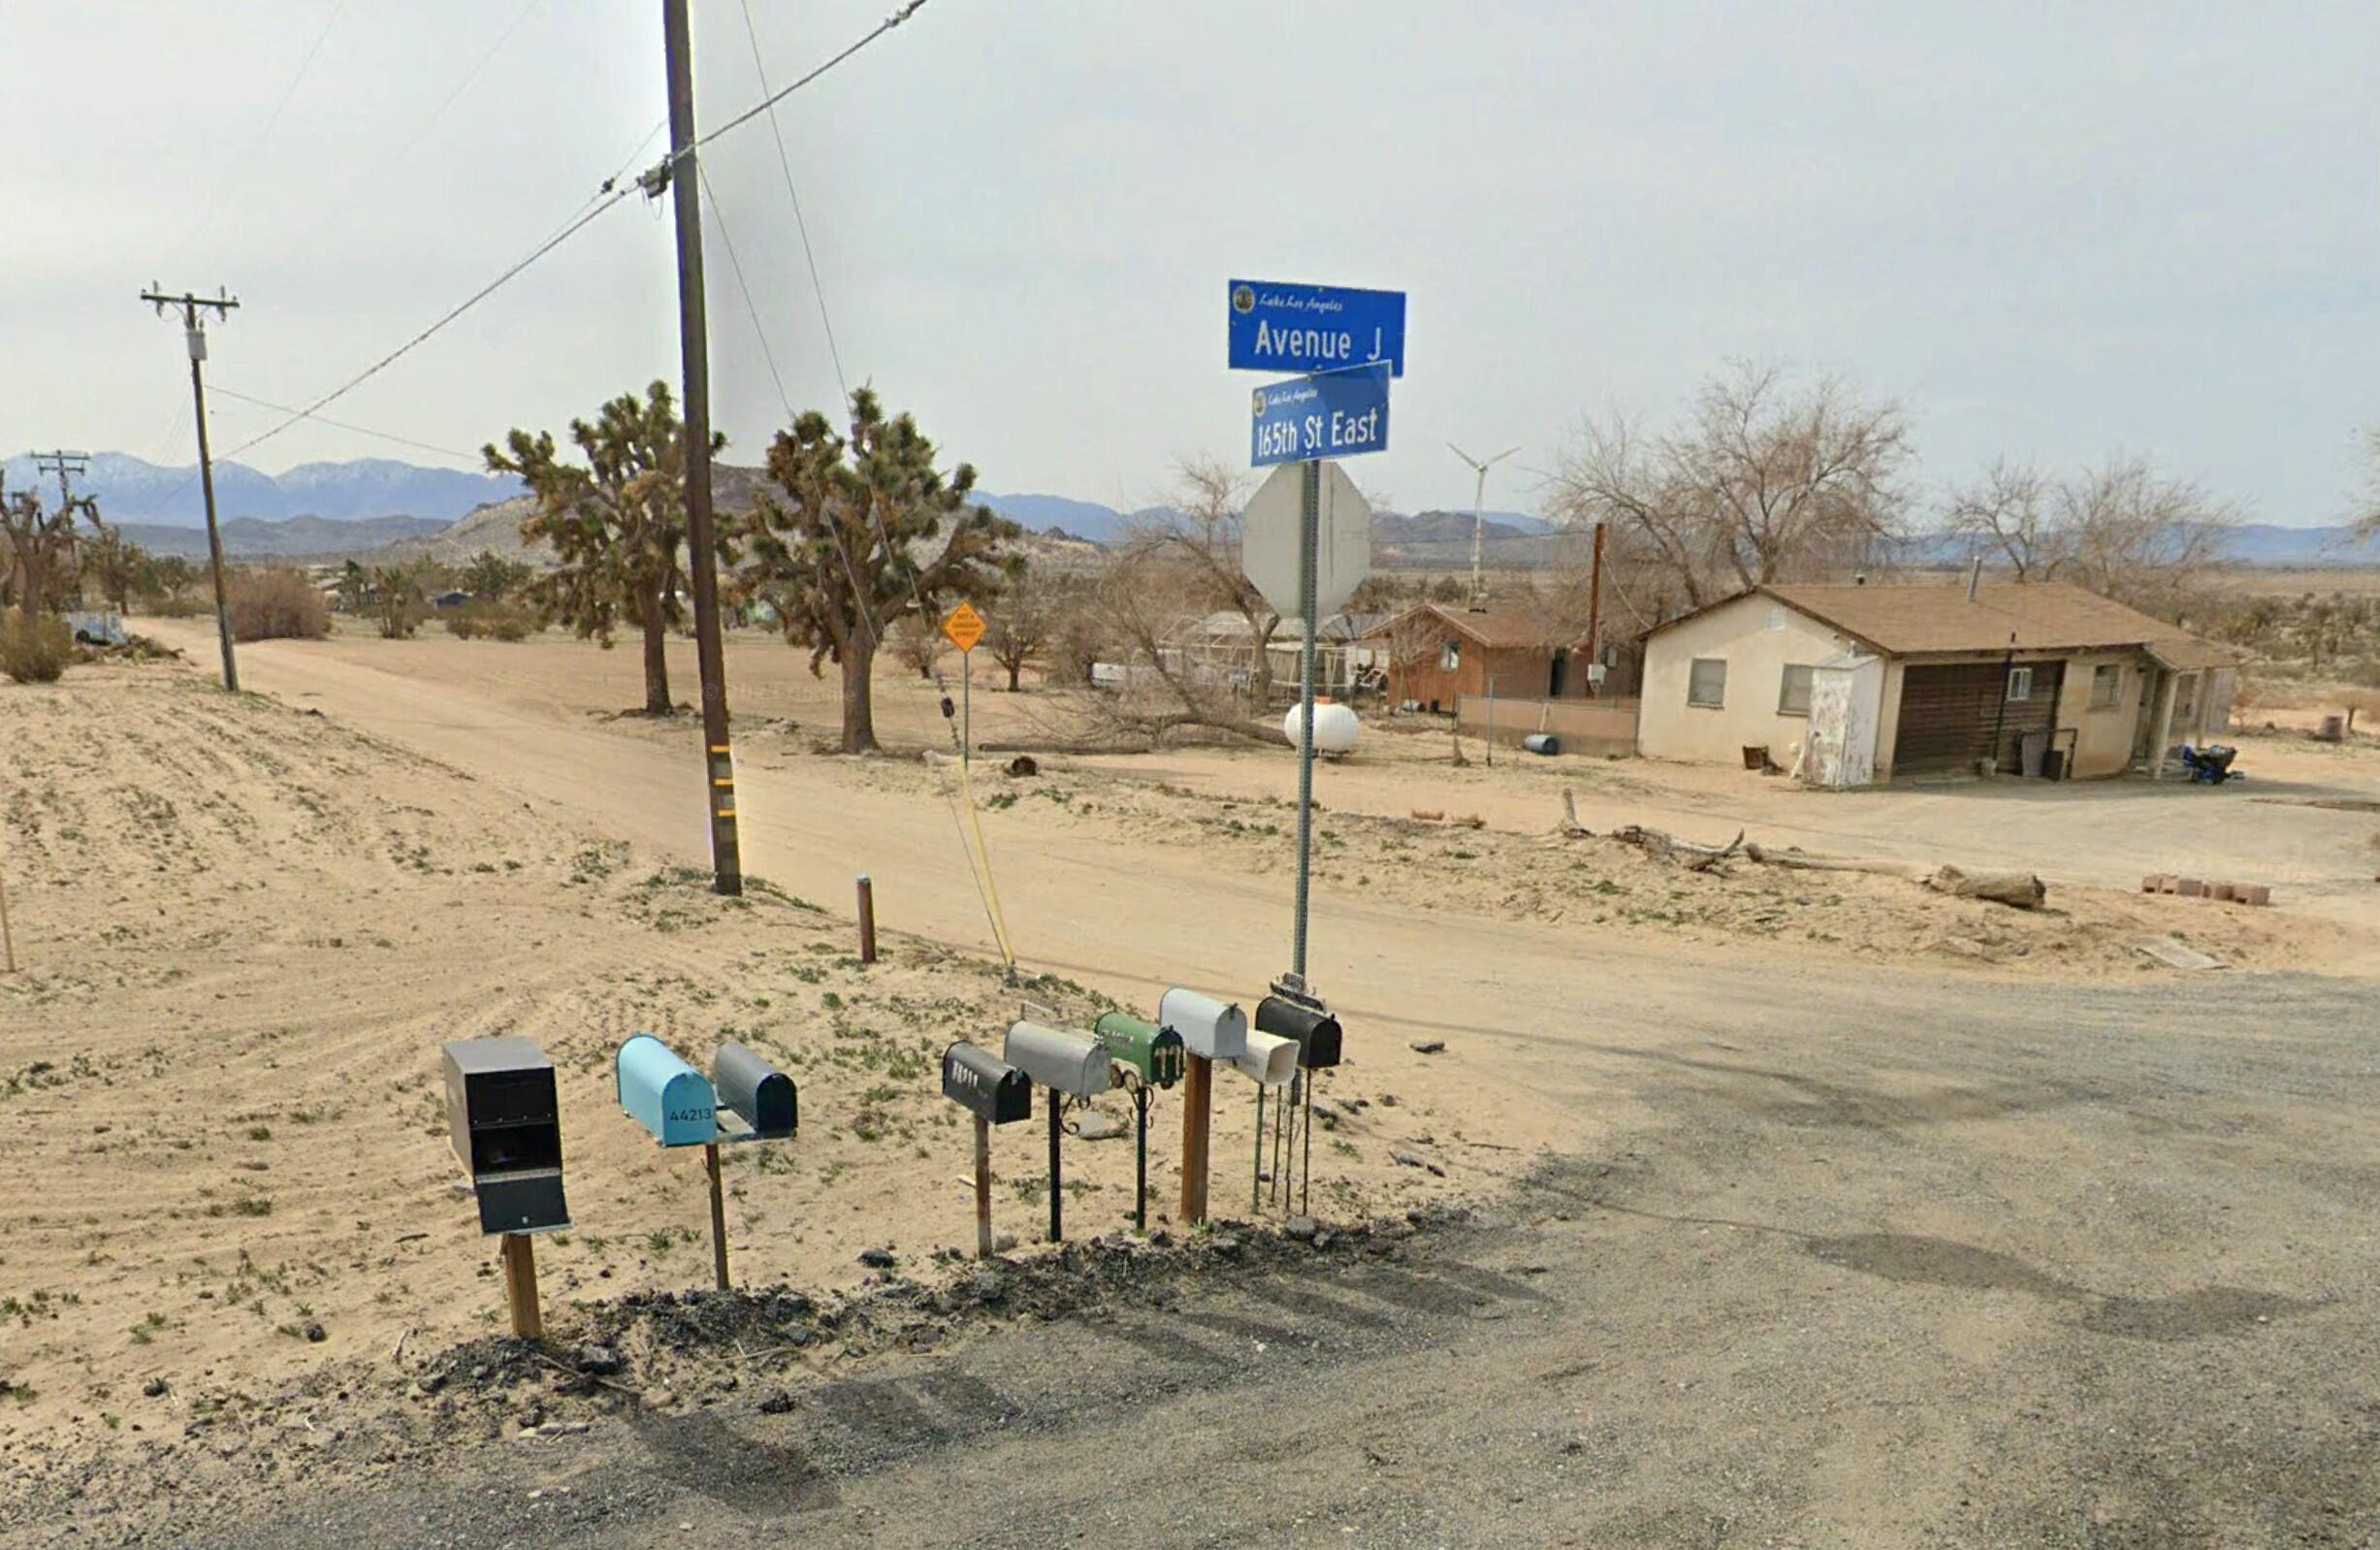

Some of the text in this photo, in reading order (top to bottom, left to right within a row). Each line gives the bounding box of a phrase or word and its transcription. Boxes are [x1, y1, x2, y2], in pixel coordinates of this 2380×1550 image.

[1259, 293, 1343, 314] Lake Los Angeles
[1254, 319, 1382, 361] Avenue J
[1258, 406, 1378, 458] 165th St East
[669, 1109, 713, 1121] 44213
